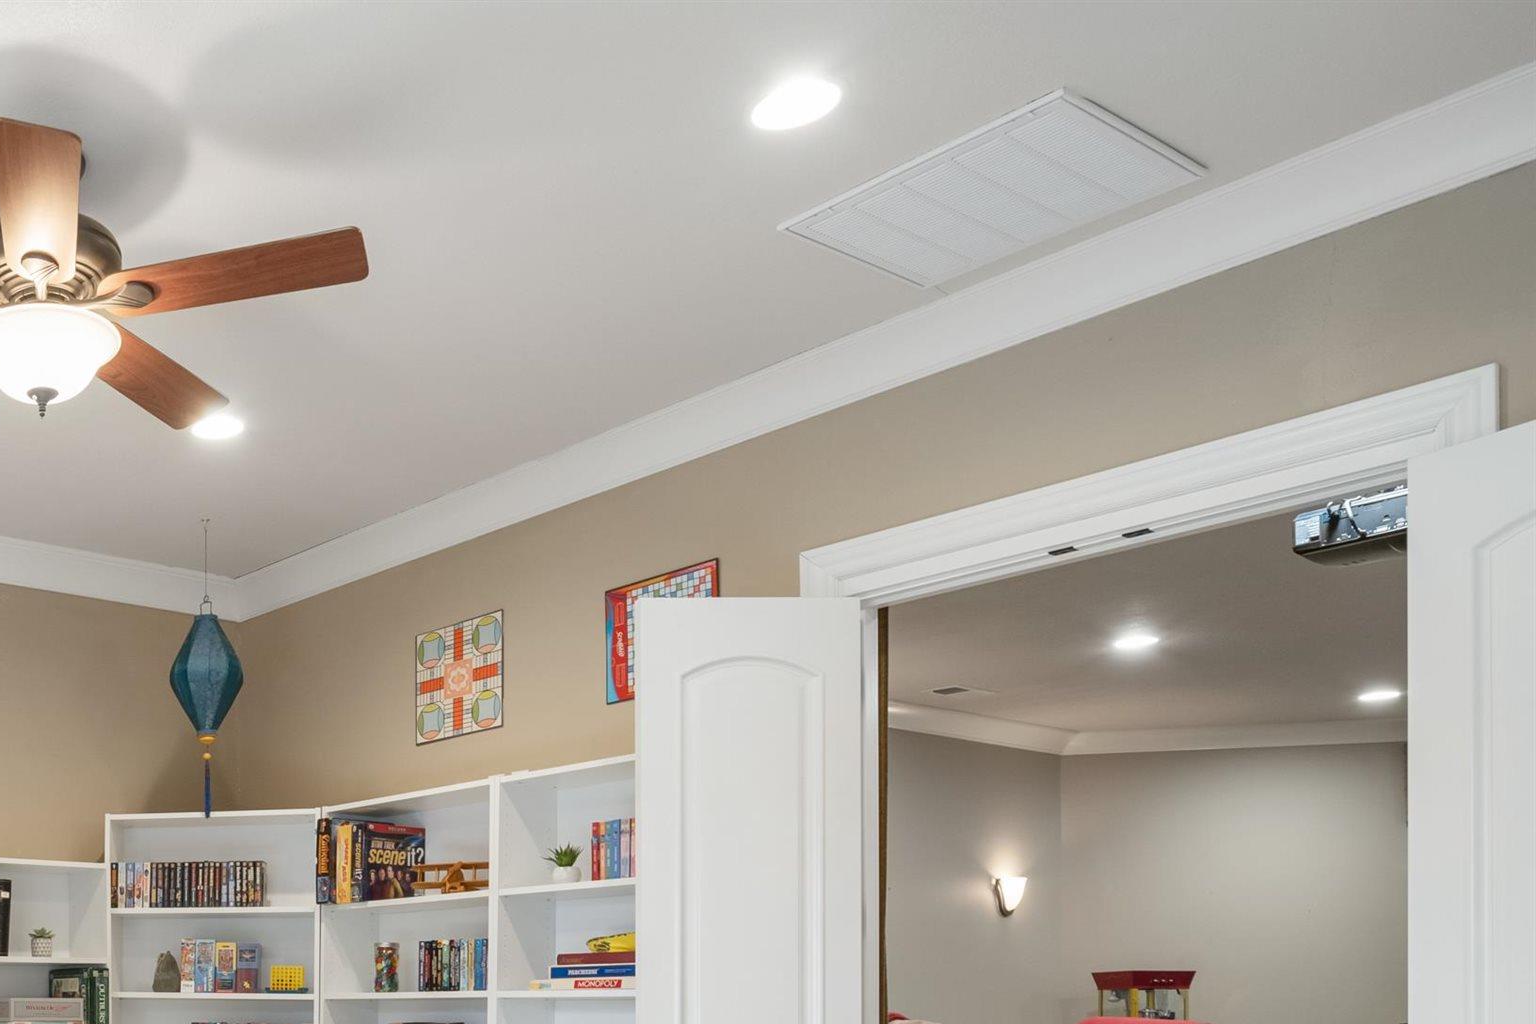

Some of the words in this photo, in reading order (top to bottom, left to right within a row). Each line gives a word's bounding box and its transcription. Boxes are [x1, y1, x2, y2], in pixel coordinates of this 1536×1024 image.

[368, 848, 406, 866] scene
[407, 847, 424, 867] it?
[577, 980, 618, 988] MONOPOLY
